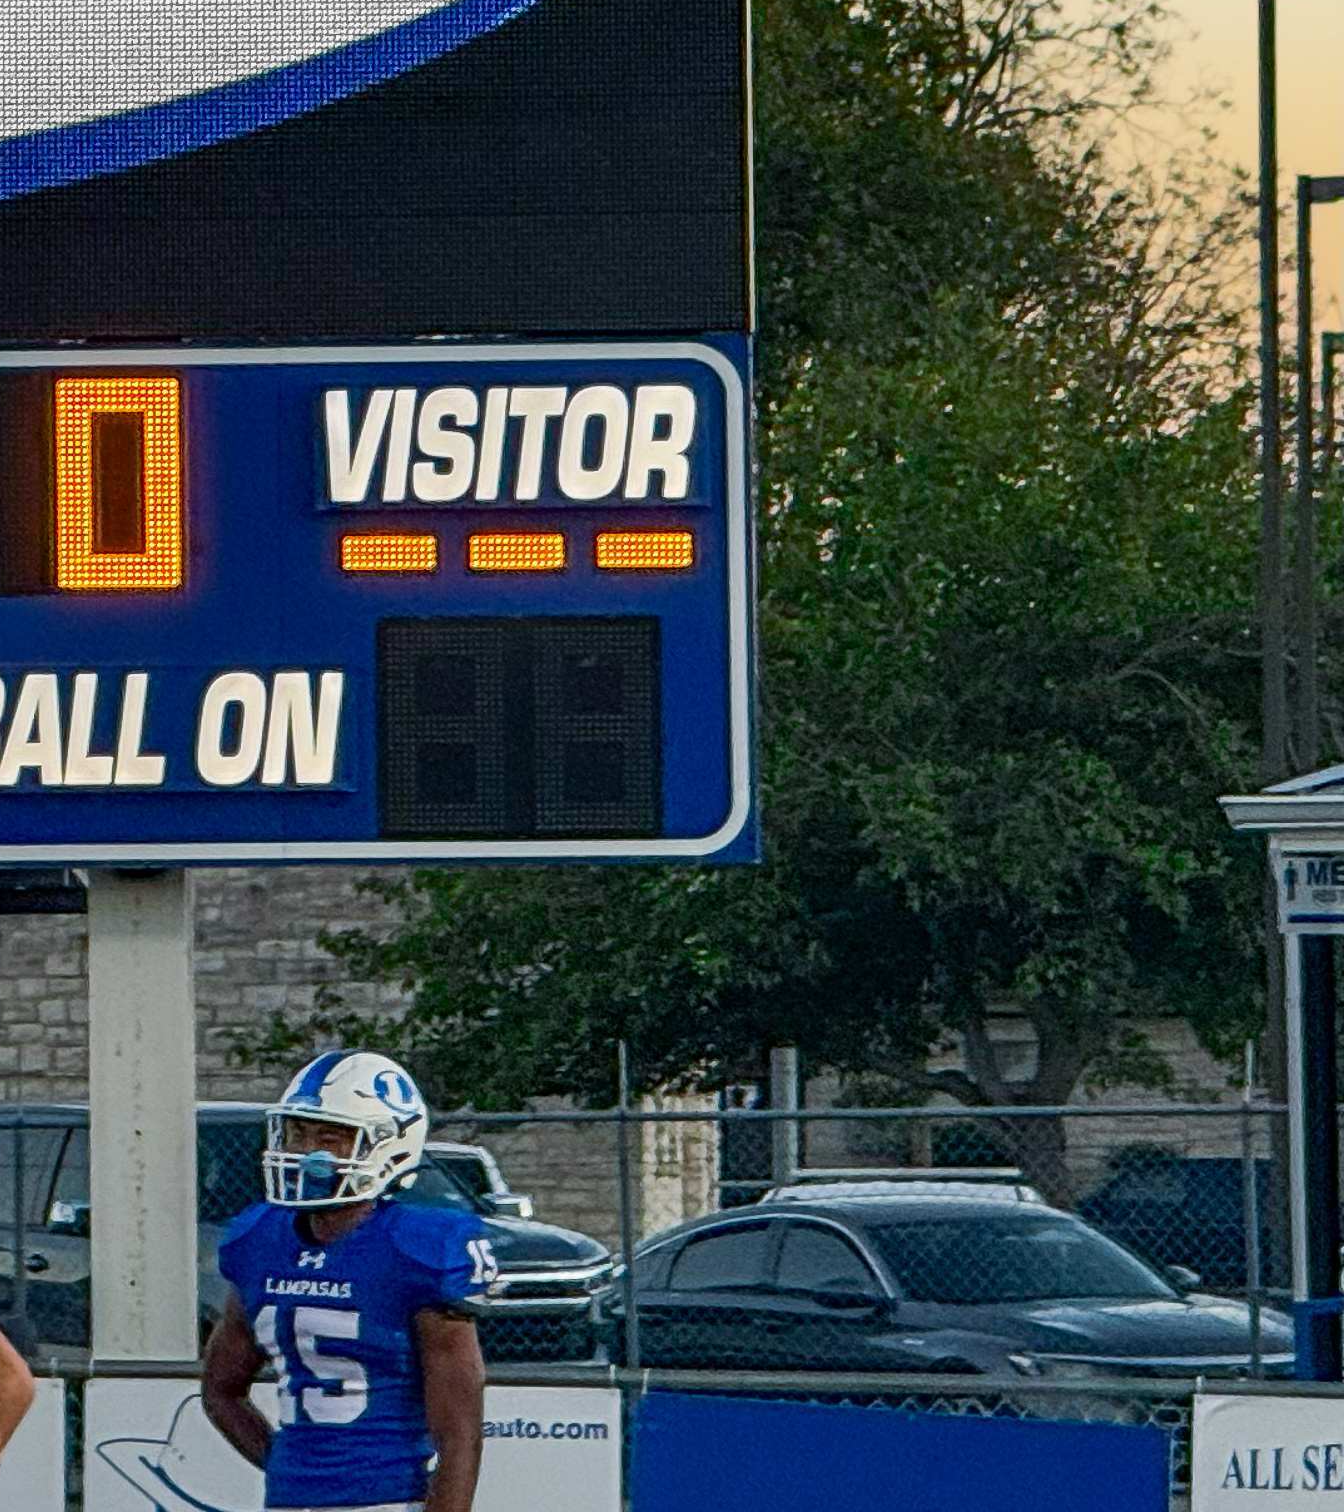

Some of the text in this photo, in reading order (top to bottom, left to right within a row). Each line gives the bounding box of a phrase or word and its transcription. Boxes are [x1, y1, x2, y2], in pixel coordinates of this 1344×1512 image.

[55, 377, 182, 589] 0
[324, 384, 697, 502] VISITOR
[196, 671, 344, 787] ON
[266, 1277, 352, 1299] LAMPASAS
[254, 1305, 369, 1424] 15
[1222, 1446, 1294, 1490] ALL
